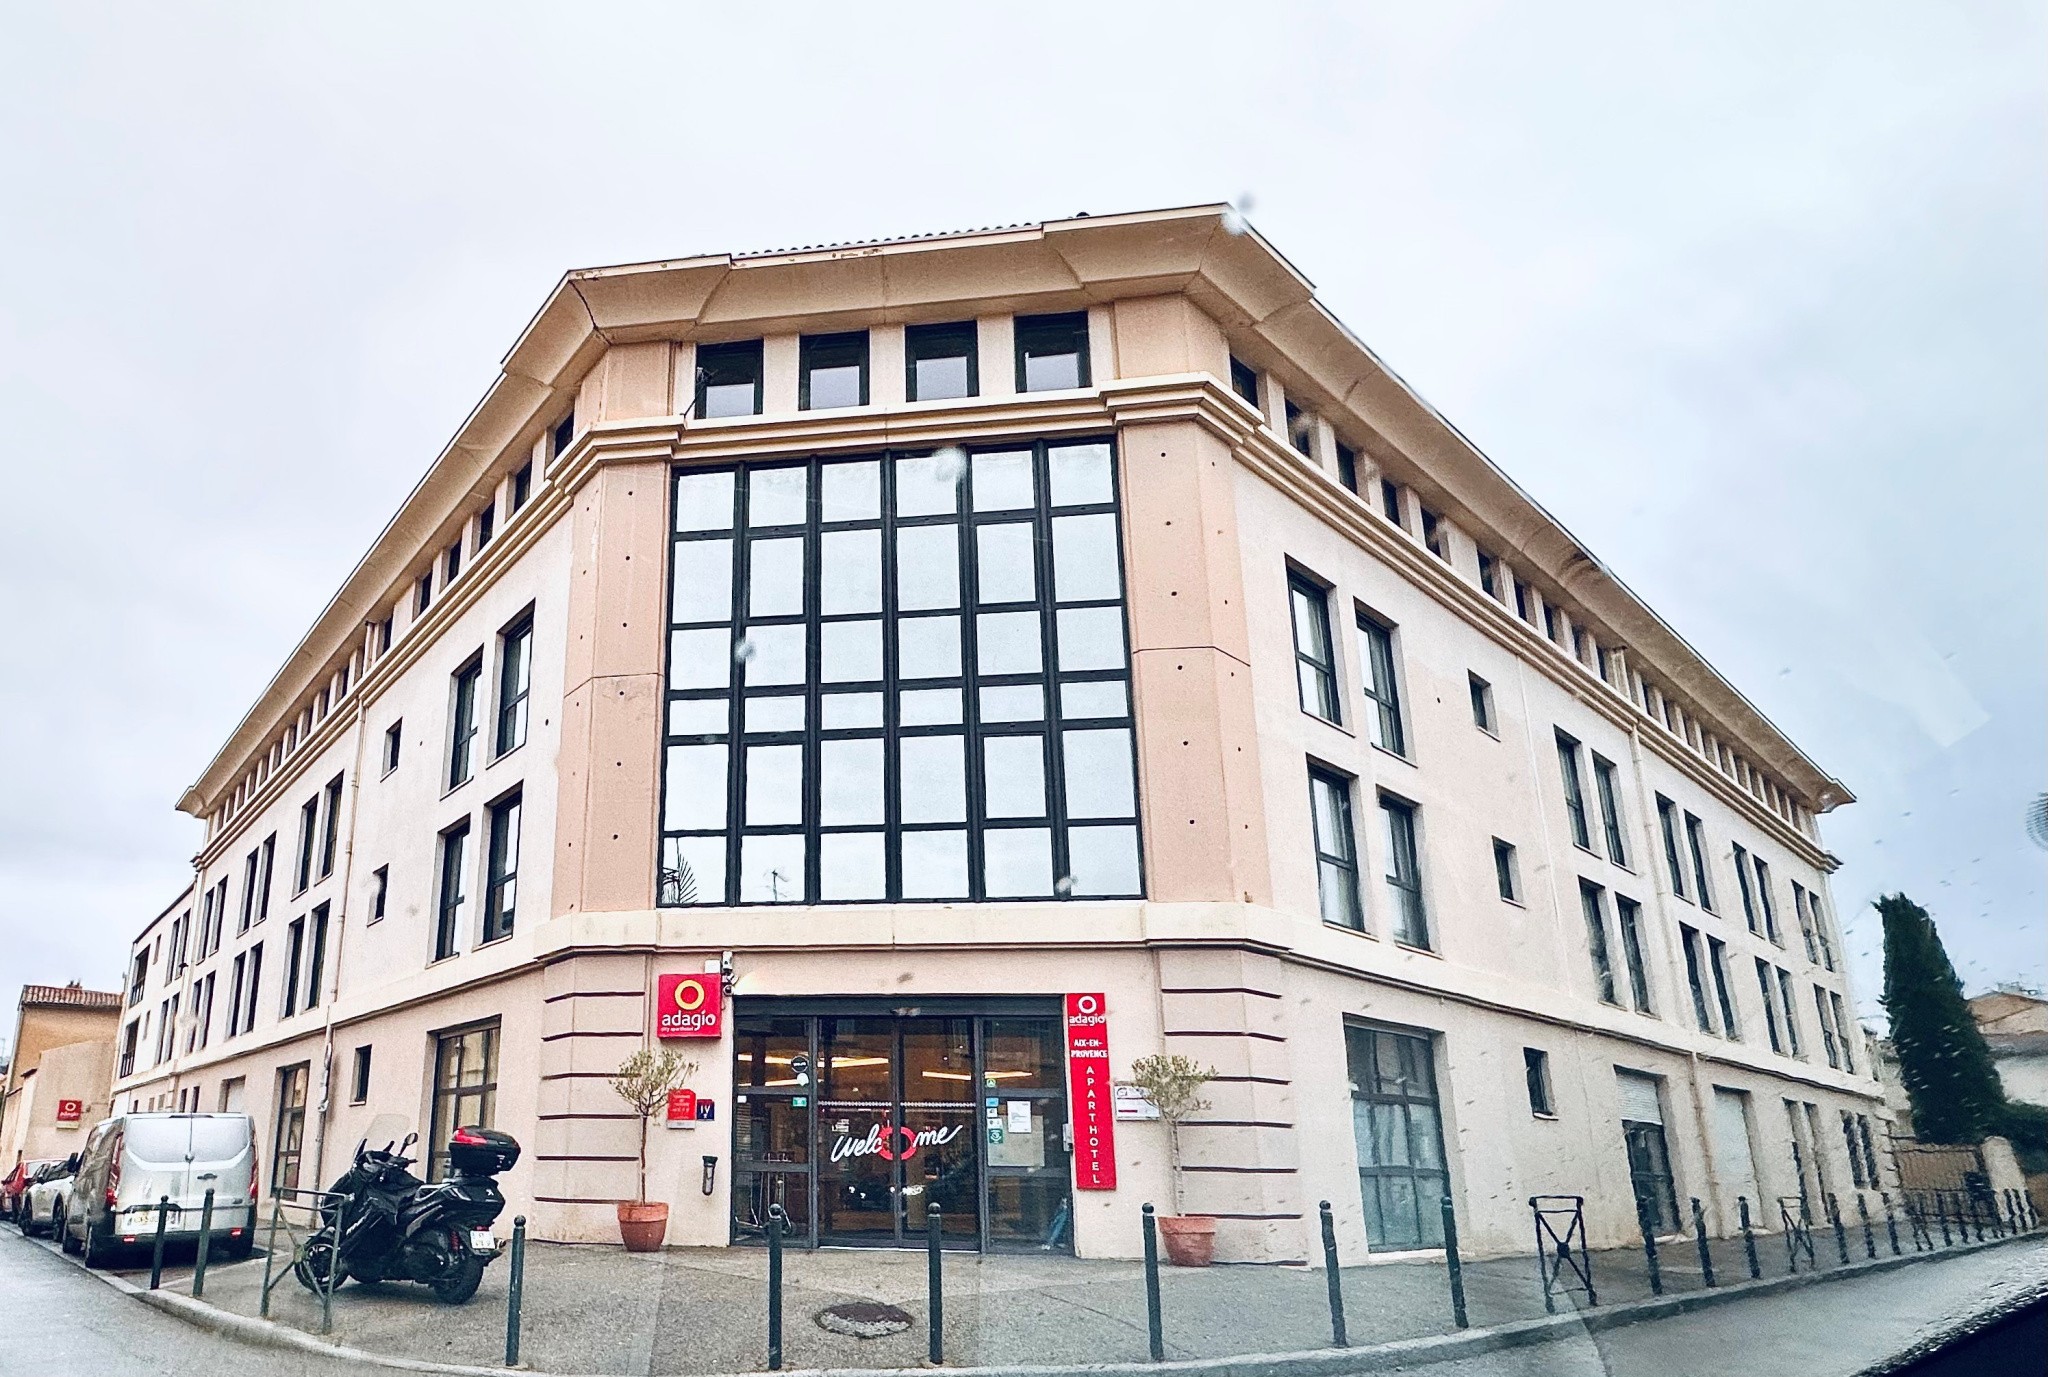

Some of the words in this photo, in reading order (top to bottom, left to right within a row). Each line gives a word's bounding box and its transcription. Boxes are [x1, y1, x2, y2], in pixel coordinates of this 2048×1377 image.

[661, 1010, 716, 1031] adagio
[1069, 1013, 1105, 1026] adagio
[1073, 1038, 1103, 1047] AIX-EN-
[1070, 1049, 1108, 1058] PROVENCE
[1086, 1065, 1100, 1184] APARTHOTEL
